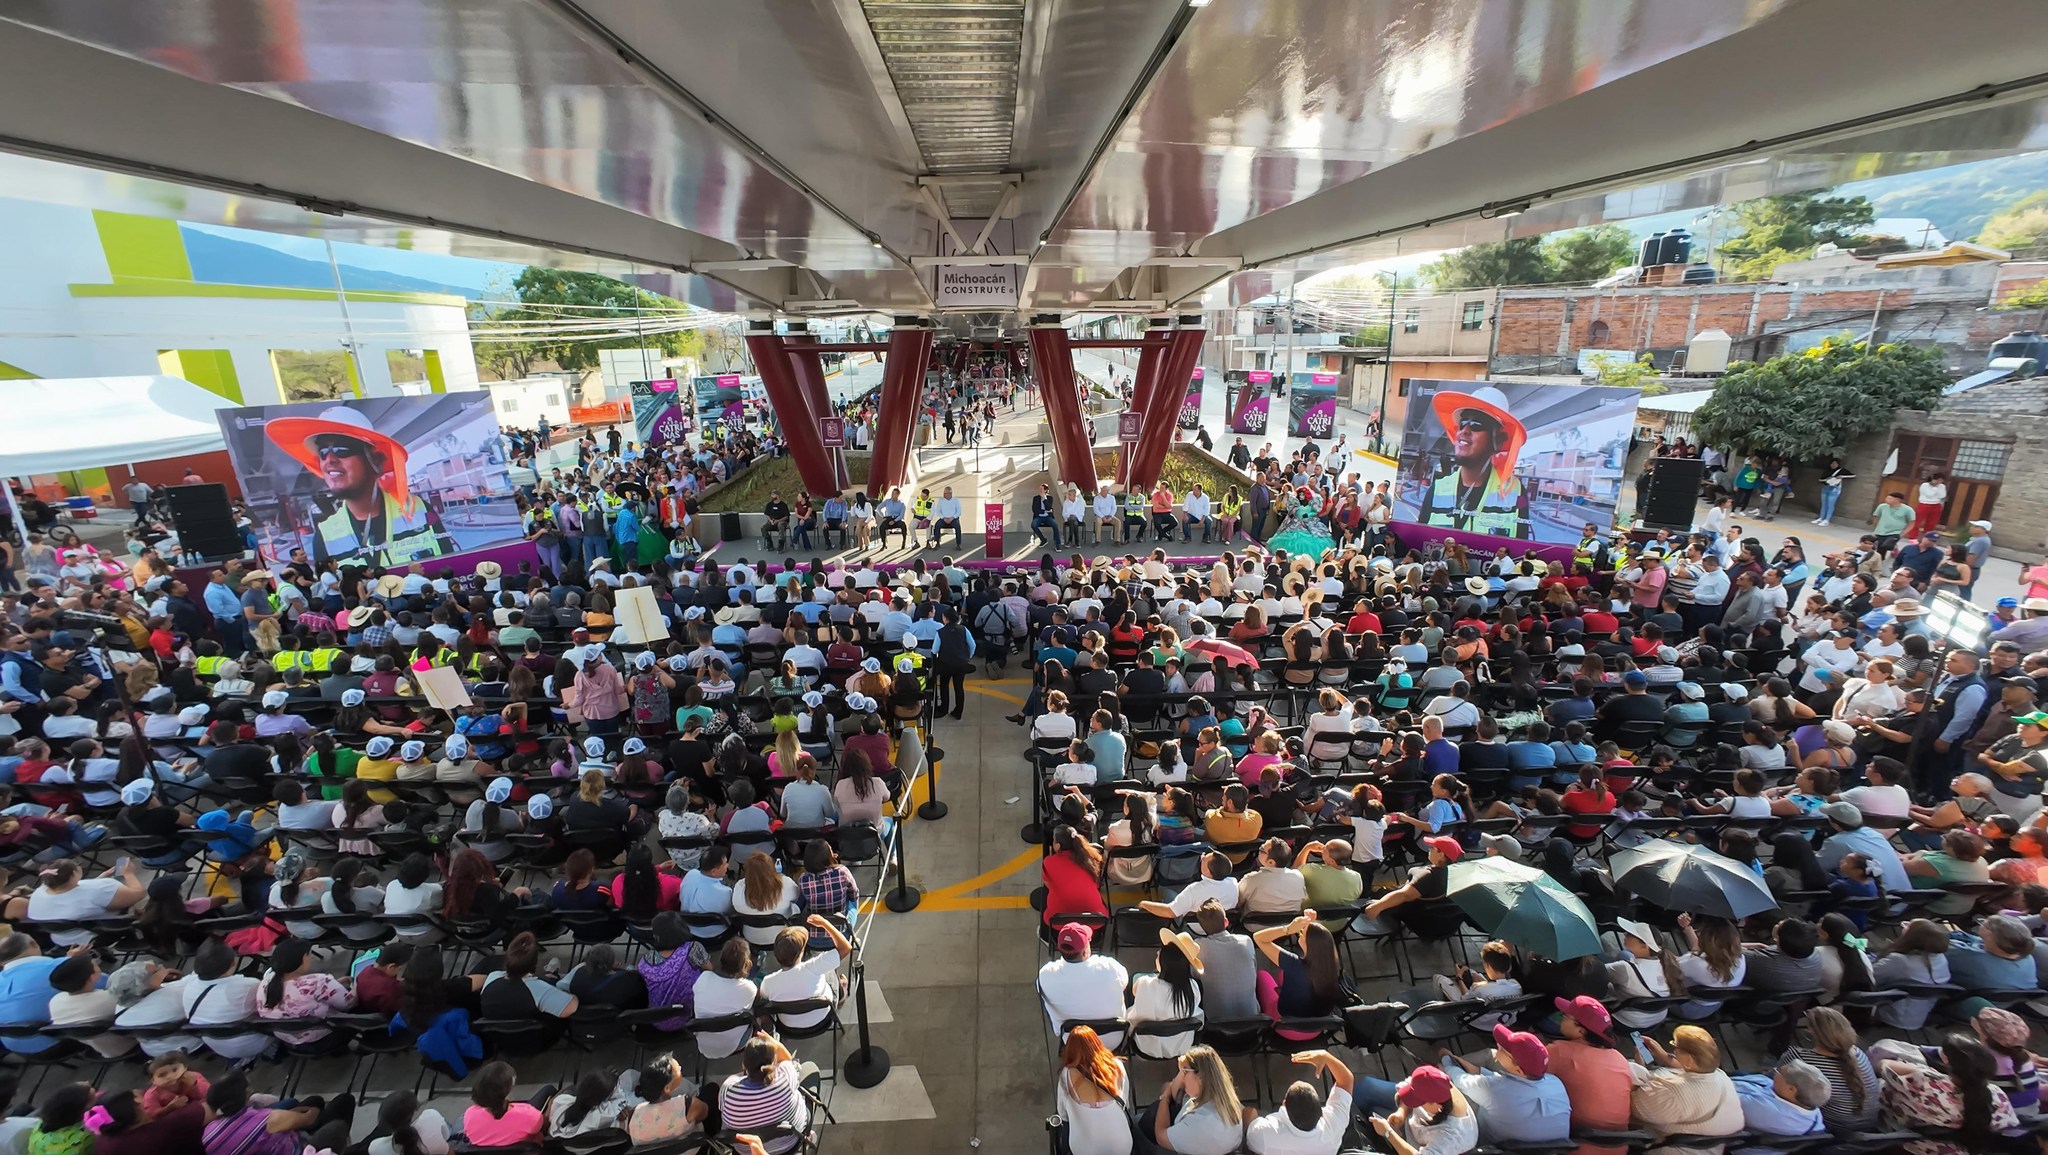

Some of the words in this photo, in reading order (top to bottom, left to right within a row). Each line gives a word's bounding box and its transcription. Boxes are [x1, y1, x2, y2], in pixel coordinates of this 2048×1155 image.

[944, 273, 1006, 284] Michoacán
[944, 286, 1006, 294] CONSTRUYE
[1180, 415, 1195, 423] NAS
[1243, 412, 1267, 422] CATRI
[1307, 416, 1332, 425] CATRI
[659, 421, 683, 433] CATRI
[1245, 420, 1262, 428] NAS
[1309, 424, 1327, 432] NAS
[663, 430, 681, 440] NAS
